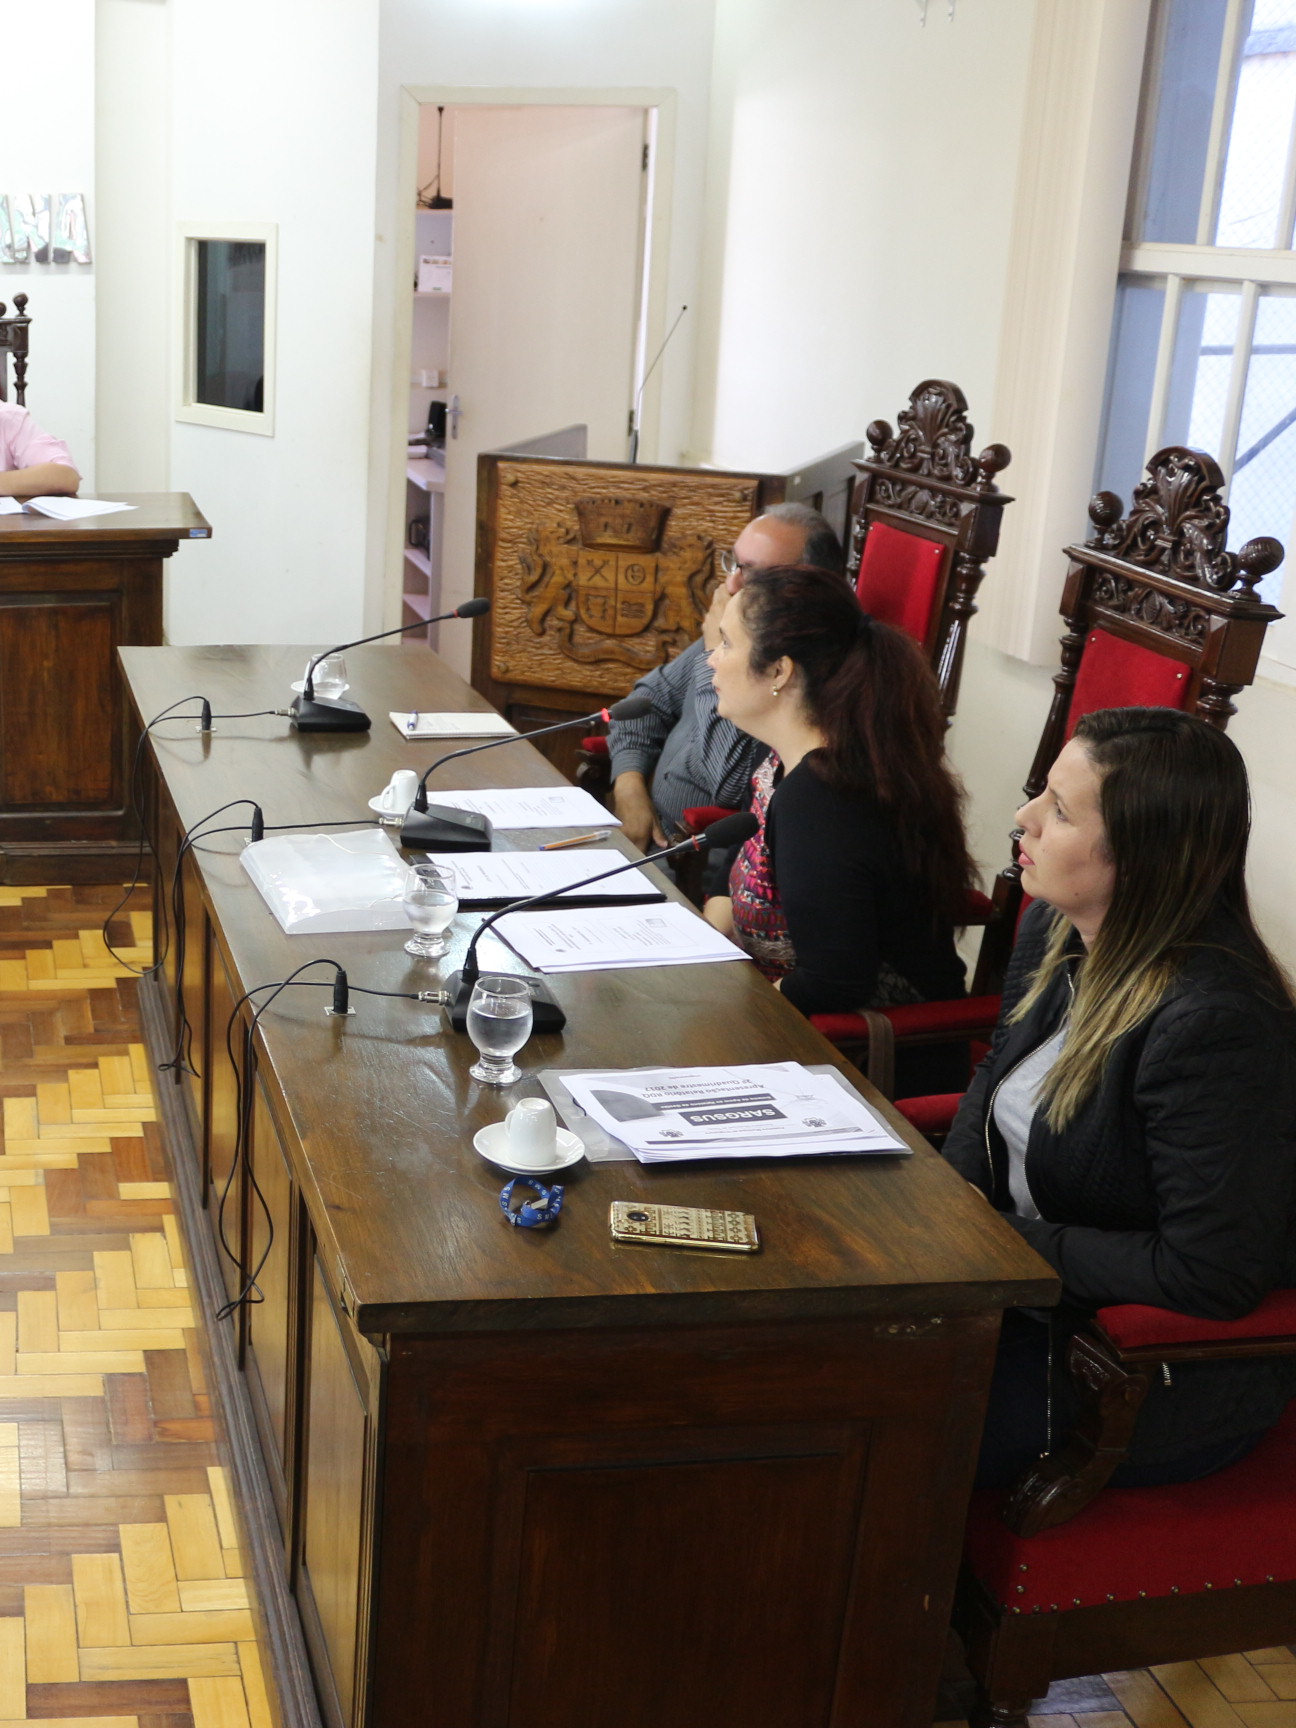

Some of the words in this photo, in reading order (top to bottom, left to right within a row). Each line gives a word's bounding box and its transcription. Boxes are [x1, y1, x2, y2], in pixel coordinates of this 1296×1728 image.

[680, 1080, 740, 1089] Quadrimestre
[705, 1084, 765, 1094] Apresentação
[666, 1089, 705, 1097] Relatório
[689, 1108, 777, 1123] SARGSUS
